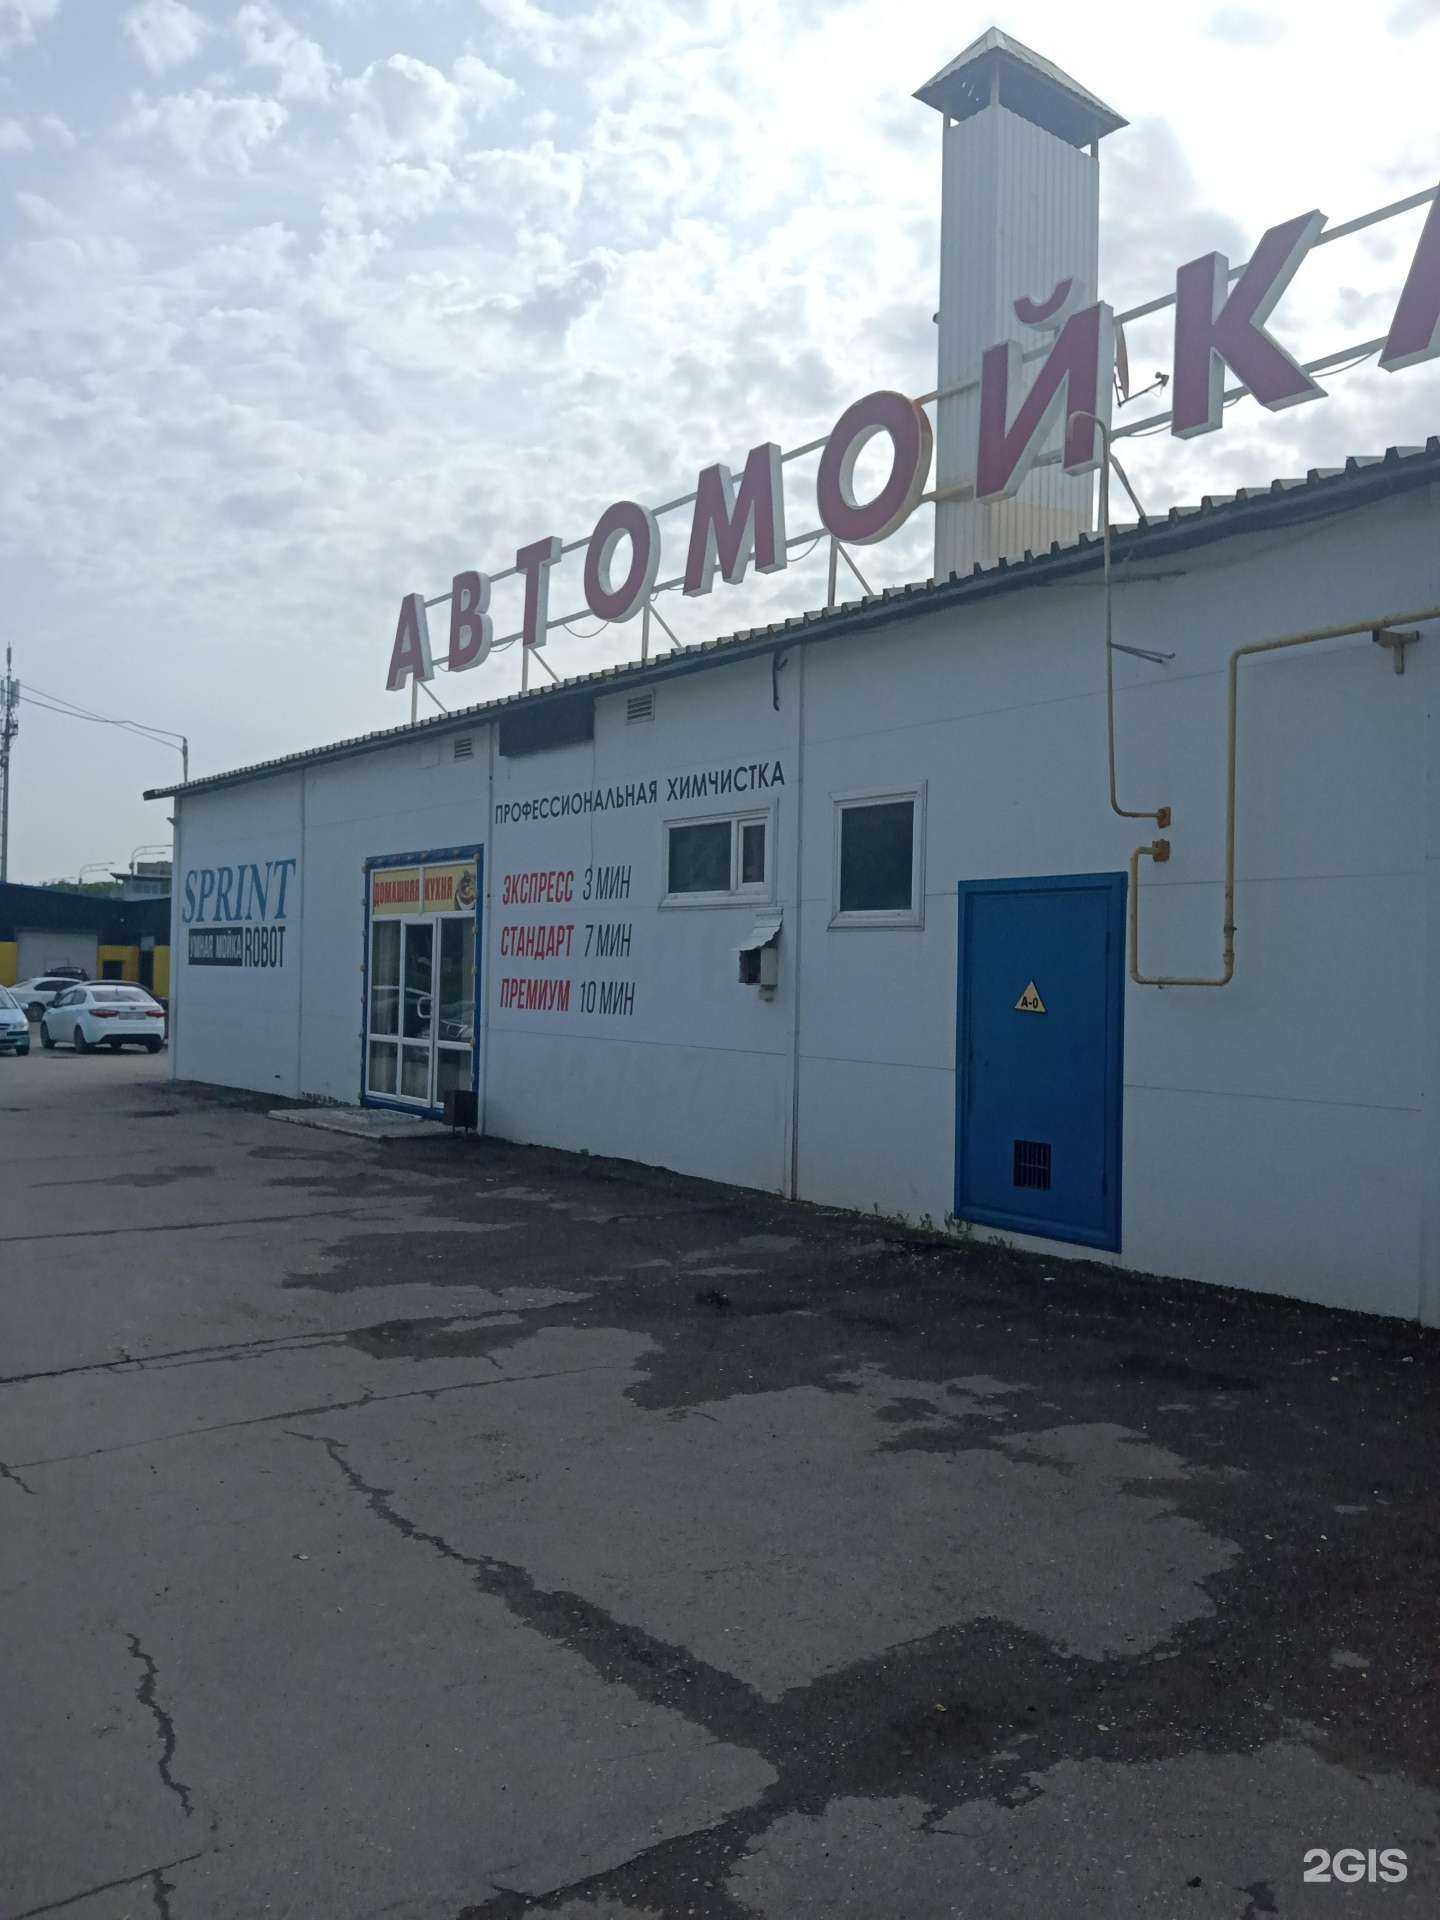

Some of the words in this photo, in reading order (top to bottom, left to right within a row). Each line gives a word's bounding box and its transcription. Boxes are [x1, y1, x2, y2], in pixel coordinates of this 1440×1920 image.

[495, 780, 658, 824] ПРОФЕССИОНАЛЬНАЯ
[666, 760, 785, 801] ХИМЧИСТКА
[182, 858, 297, 923] SPRINT
[502, 870, 575, 905] ЭКСПРЕСС
[583, 867, 593, 900] 3
[595, 864, 632, 900] МИН
[244, 926, 286, 968] ROBOT
[501, 925, 575, 960] СТАНДАРТ
[584, 924, 594, 957] 7
[596, 923, 633, 957] МИН
[500, 978, 571, 1011] ПРЕМИУМ
[580, 981, 596, 1013] 10
[599, 981, 635, 1016] МИН
